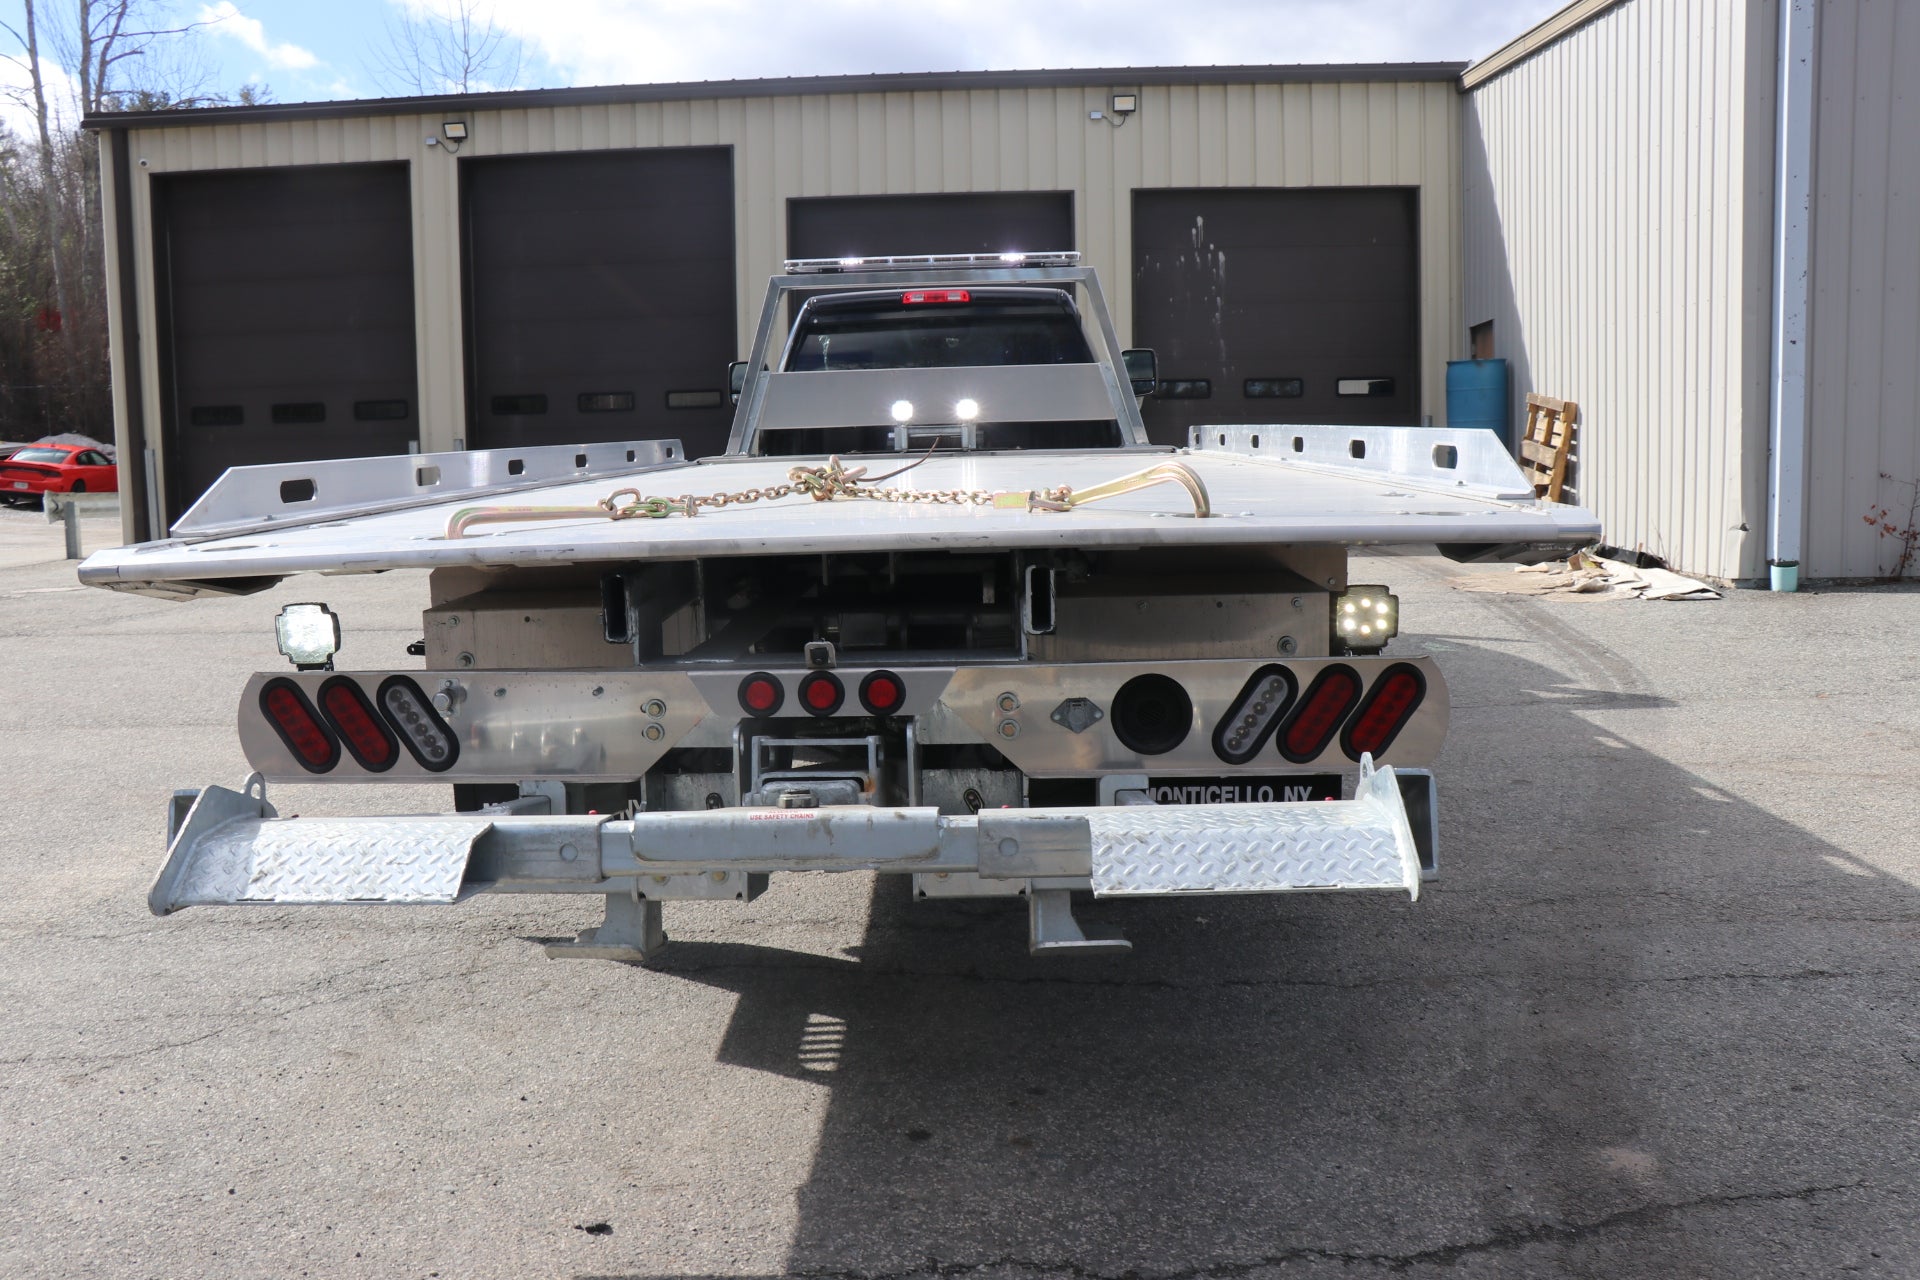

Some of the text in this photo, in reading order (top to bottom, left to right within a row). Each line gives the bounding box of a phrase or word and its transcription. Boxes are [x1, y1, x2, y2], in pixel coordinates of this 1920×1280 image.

[1284, 785, 1312, 802] NY
[764, 812, 788, 820] SAFETY
[790, 812, 815, 820] CHAINS
